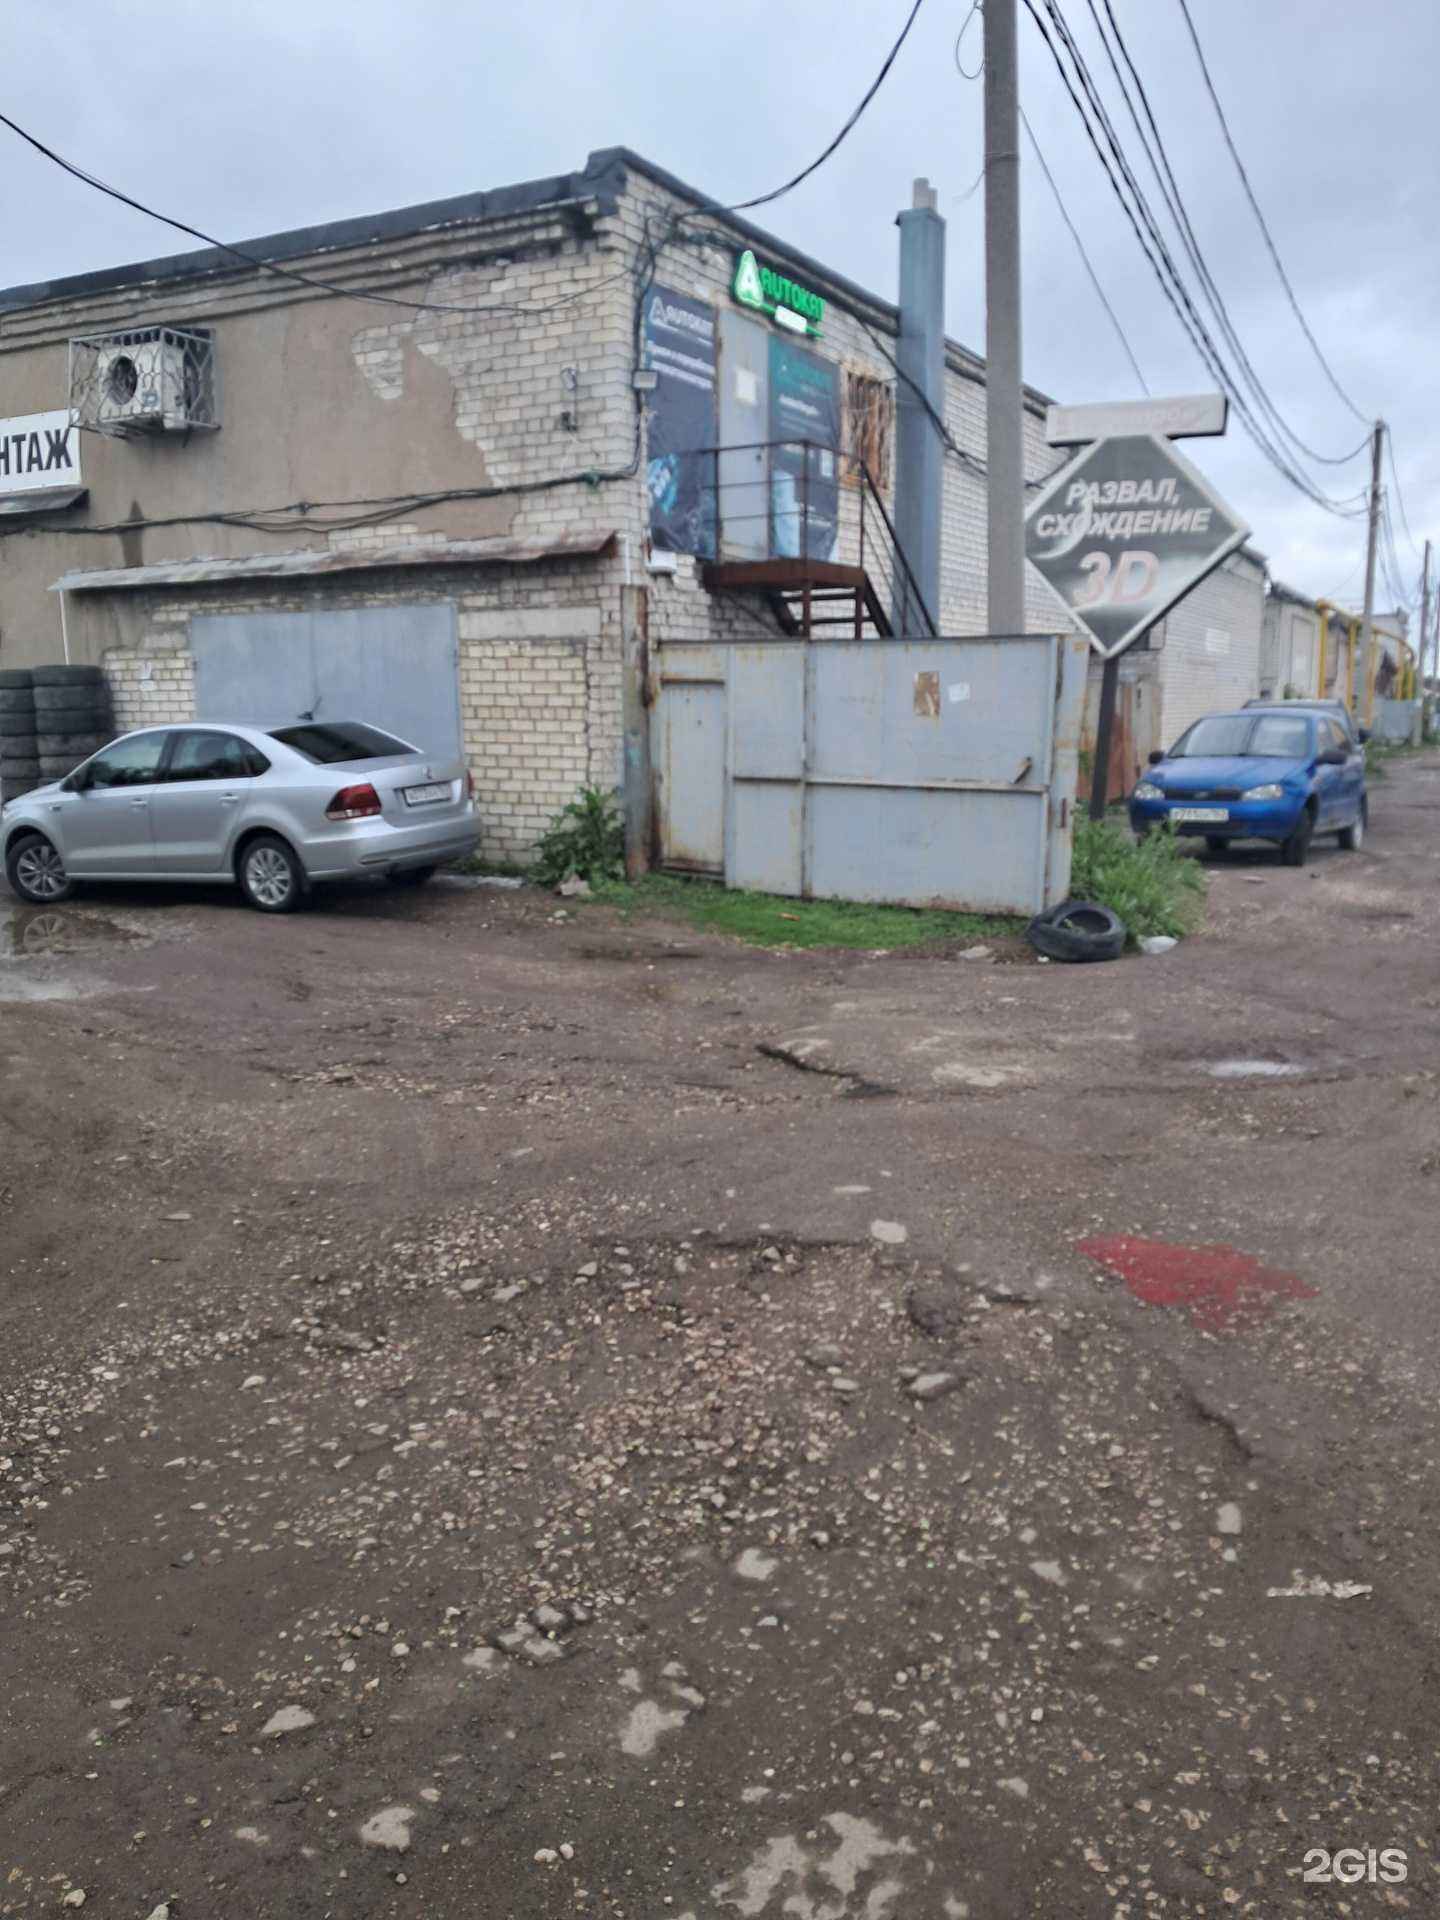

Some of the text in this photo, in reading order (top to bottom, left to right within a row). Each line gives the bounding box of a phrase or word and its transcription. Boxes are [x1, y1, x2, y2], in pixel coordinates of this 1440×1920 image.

[1065, 478, 1181, 506] РАЗВАЛ,
[1036, 507, 1212, 540] СХОЖДЕНИЕ
[1073, 550, 1160, 605] 3D
